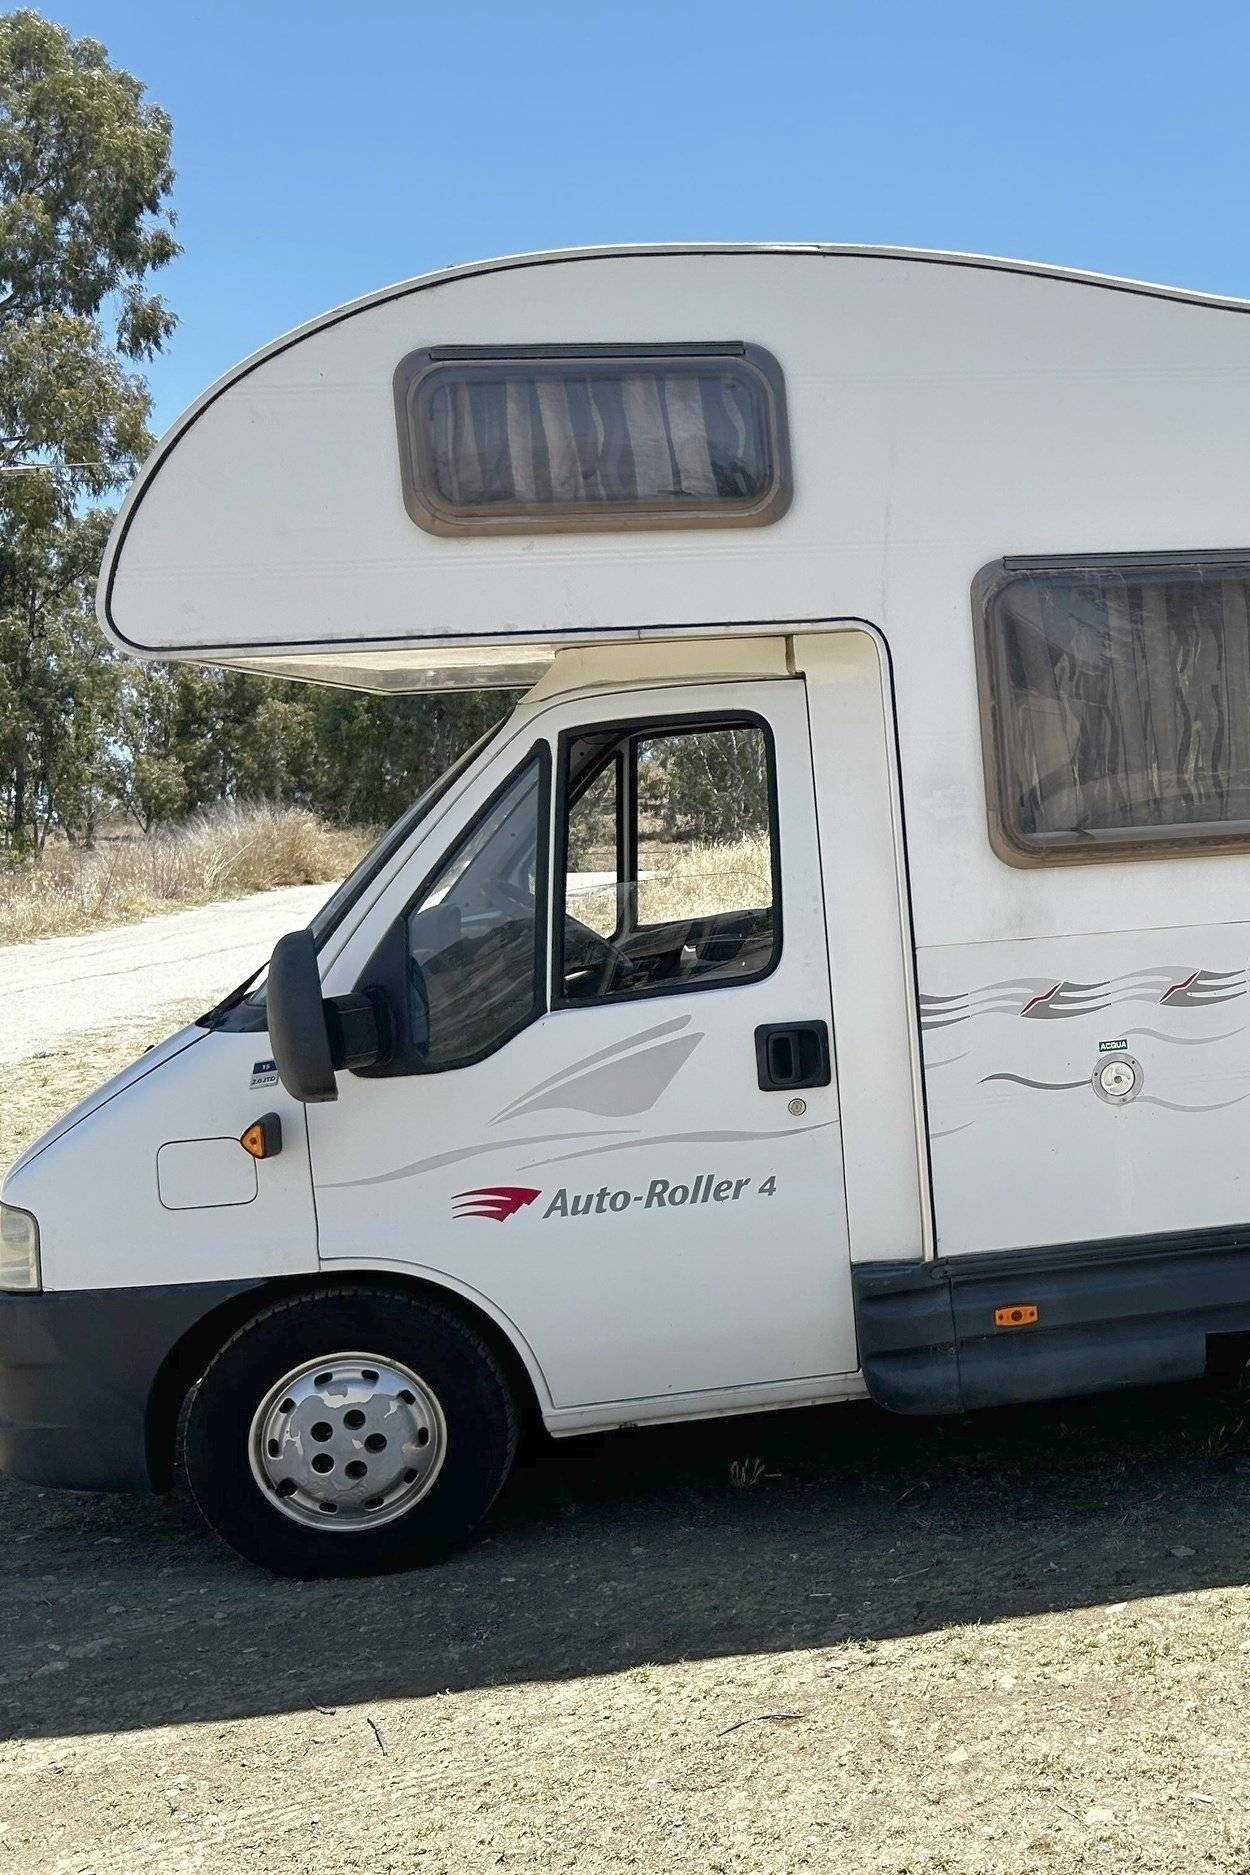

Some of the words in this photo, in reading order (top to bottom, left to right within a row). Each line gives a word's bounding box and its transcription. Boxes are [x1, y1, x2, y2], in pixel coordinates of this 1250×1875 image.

[1100, 1041, 1127, 1051] ACQUA
[542, 1174, 751, 1218] Auto-Roller
[758, 1176, 777, 1197] 4
